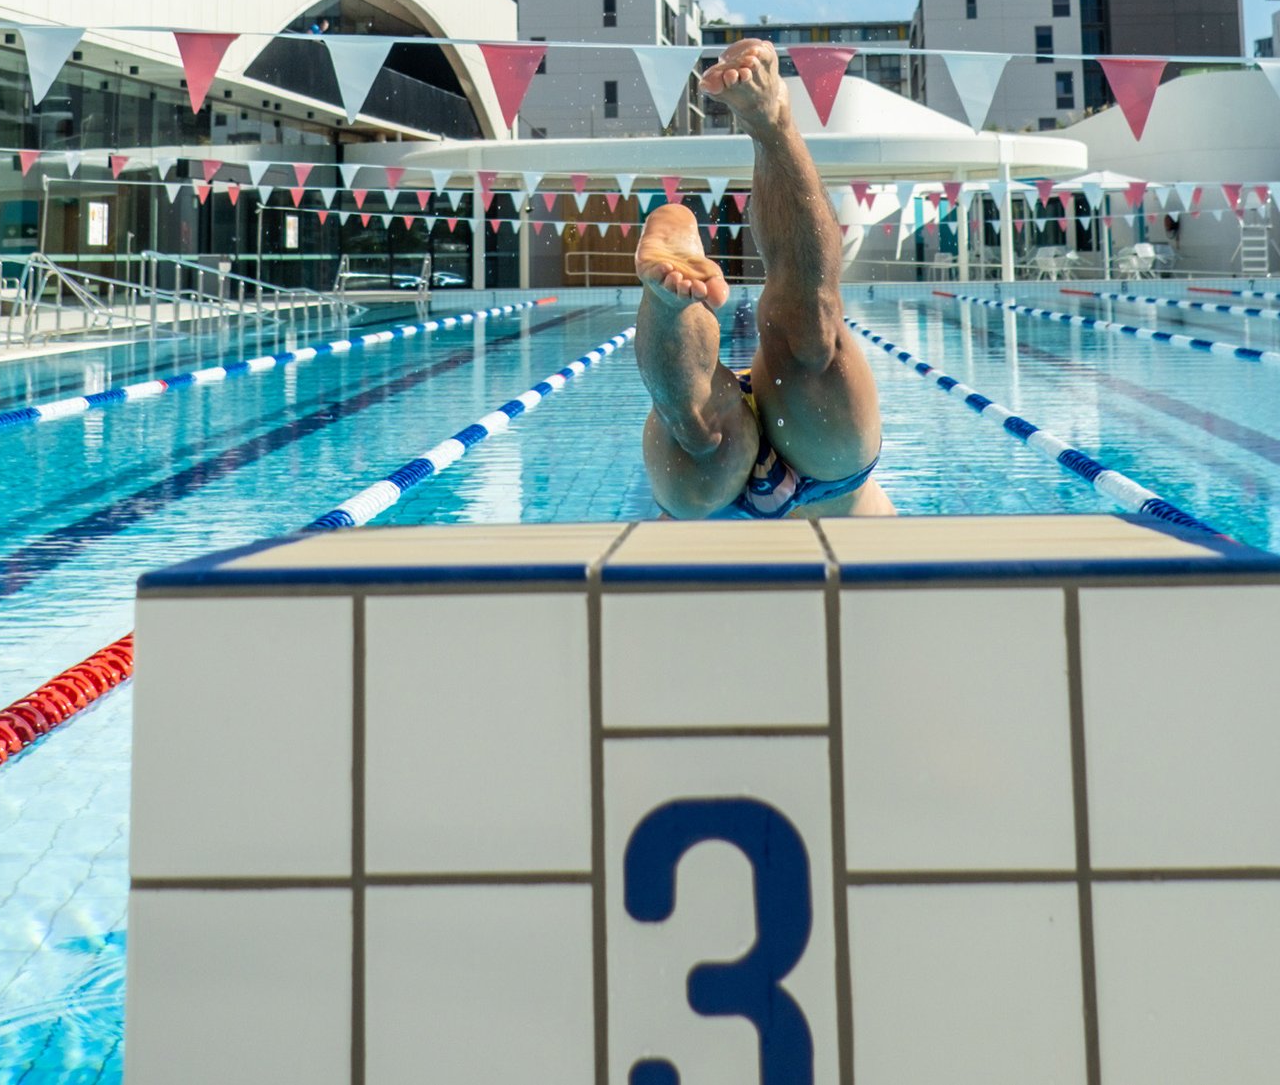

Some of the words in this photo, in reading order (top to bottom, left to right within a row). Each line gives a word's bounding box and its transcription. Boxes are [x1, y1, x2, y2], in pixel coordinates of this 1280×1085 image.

[993, 283, 1001, 294] 5
[1121, 281, 1129, 293] 6
[1248, 279, 1256, 290] 7
[616, 288, 623, 299] 2
[741, 287, 748, 297] 3
[867, 285, 875, 296] 4
[491, 291, 497, 303] 1
[623, 794, 814, 1085] 3
